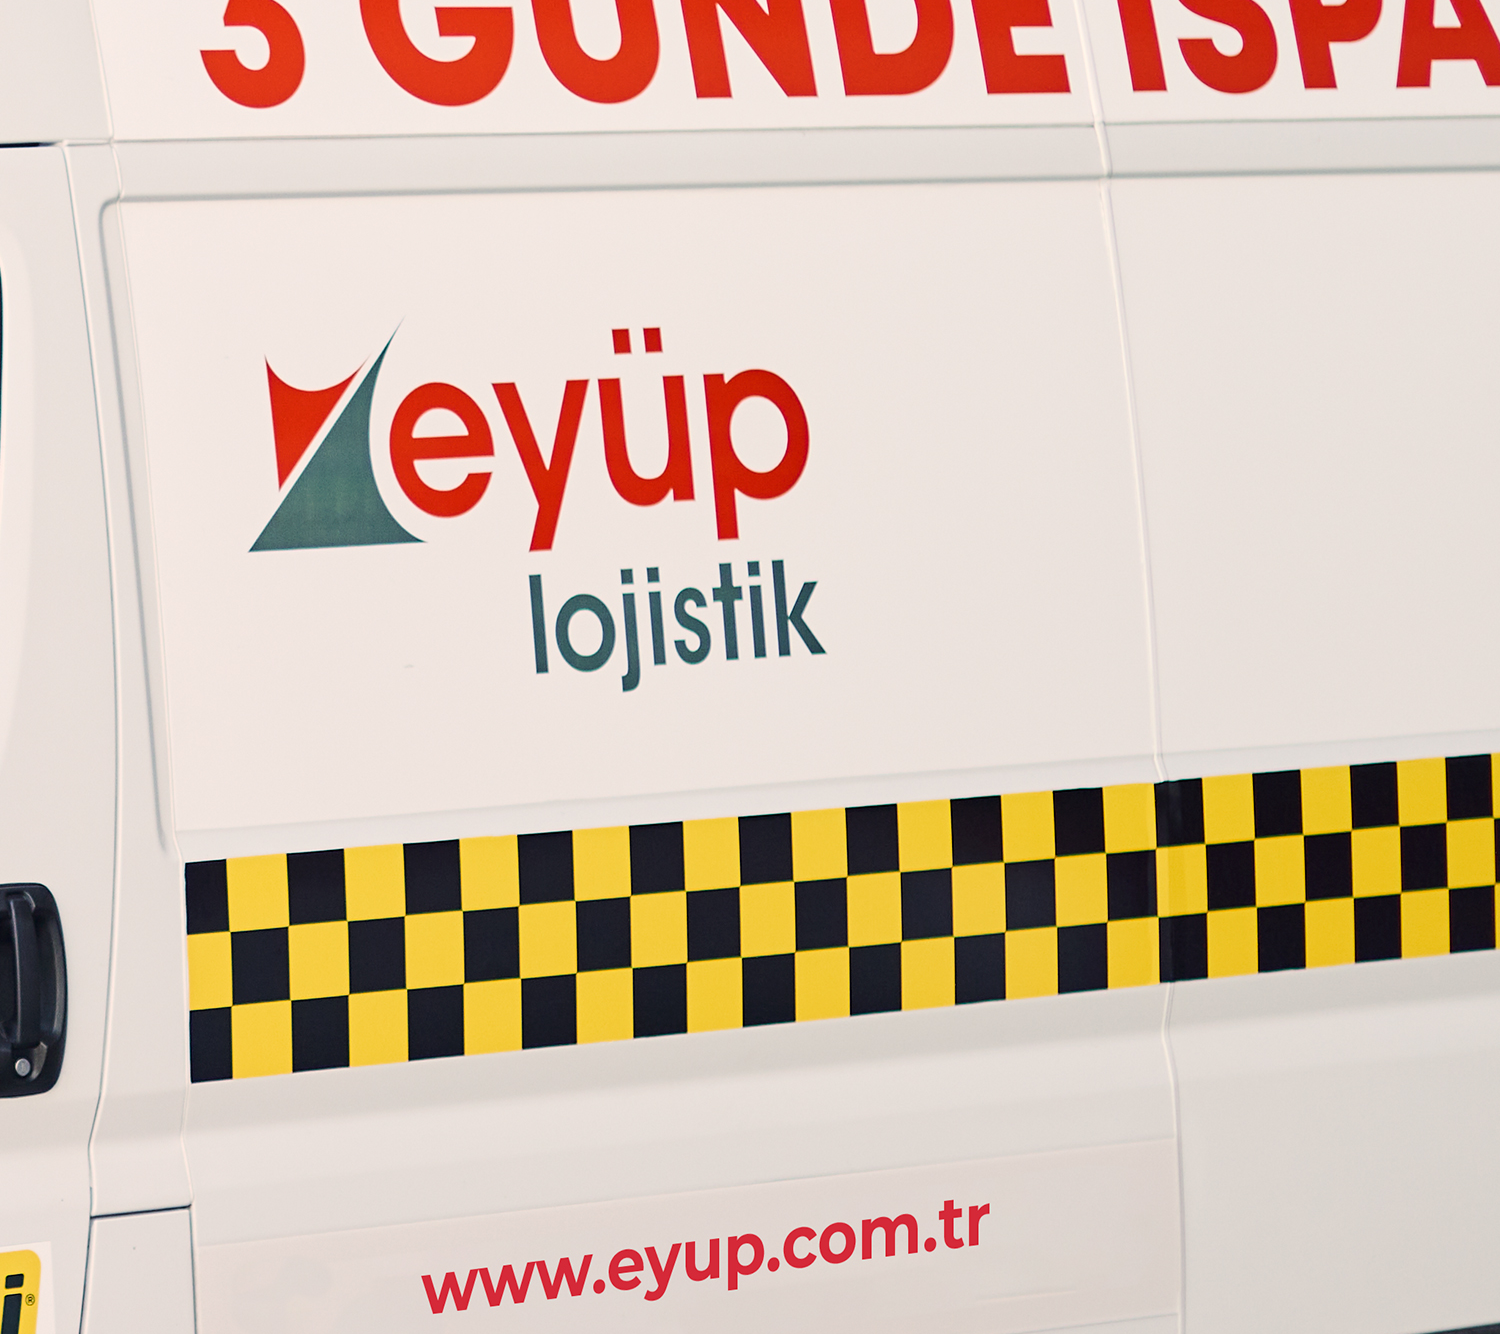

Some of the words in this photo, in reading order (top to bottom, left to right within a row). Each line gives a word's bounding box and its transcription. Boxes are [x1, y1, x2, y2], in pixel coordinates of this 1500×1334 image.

[389, 327, 810, 552] eyüp
[529, 559, 826, 692] lojistik
[421, 1200, 990, 1314] www.eyup.com.tr
